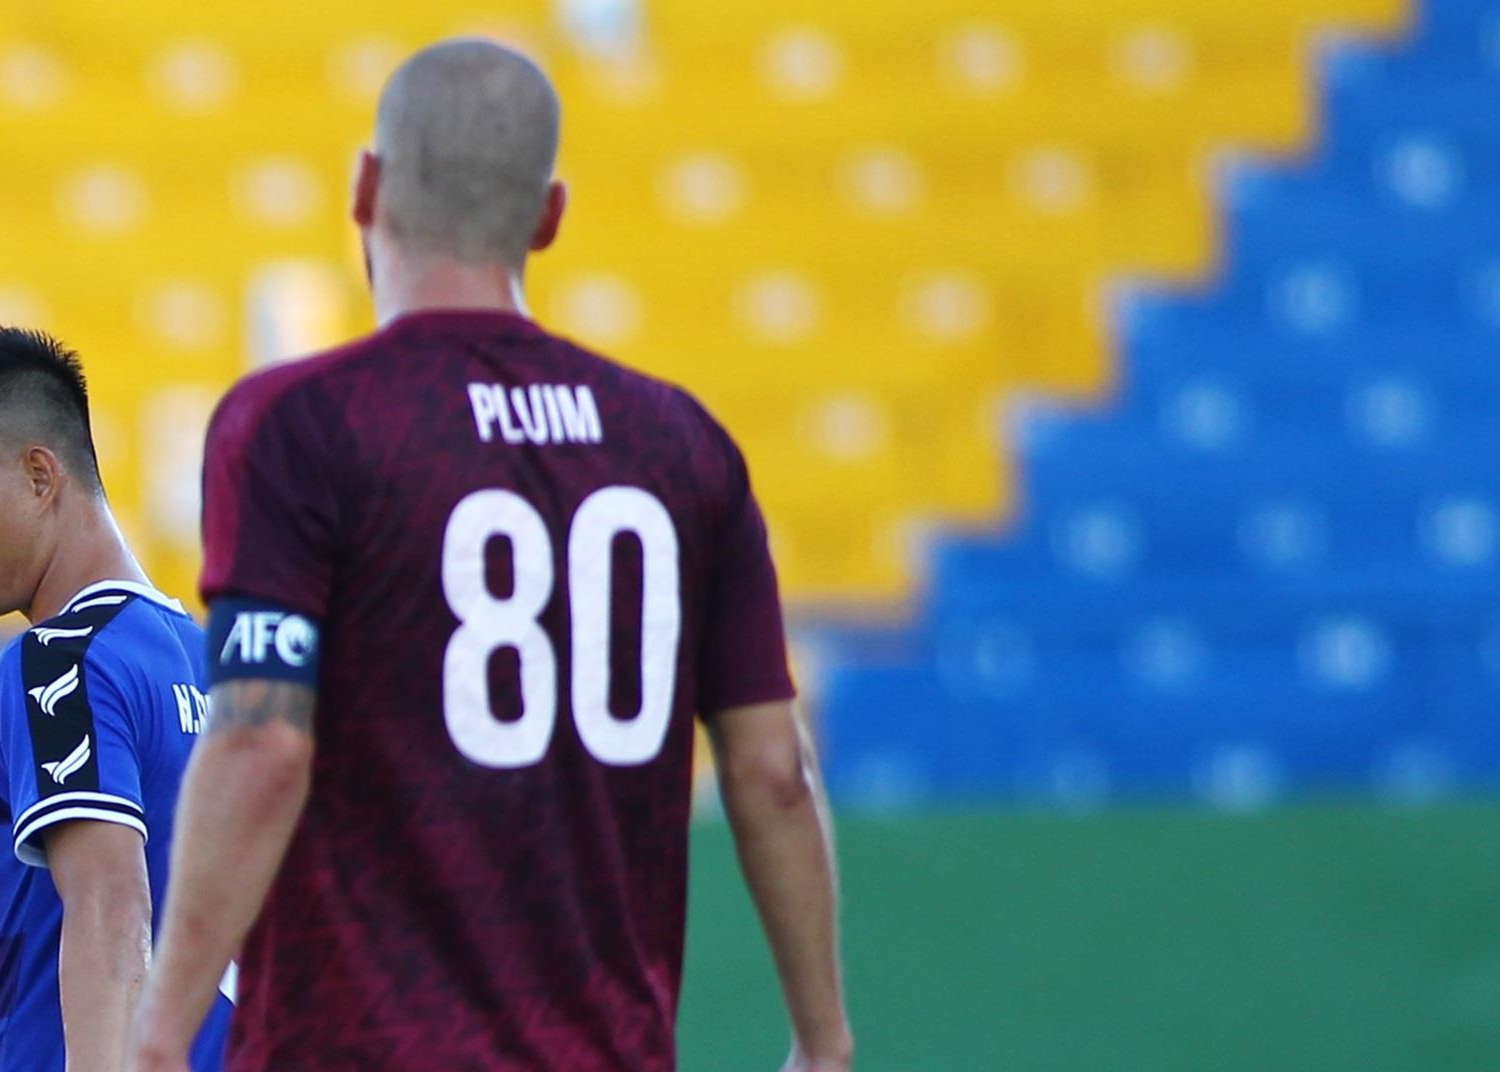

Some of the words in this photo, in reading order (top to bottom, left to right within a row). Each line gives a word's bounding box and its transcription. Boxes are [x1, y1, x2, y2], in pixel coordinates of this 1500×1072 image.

[467, 383, 602, 444] PLUIM
[220, 611, 318, 668] AFC
[441, 485, 681, 769] 80
